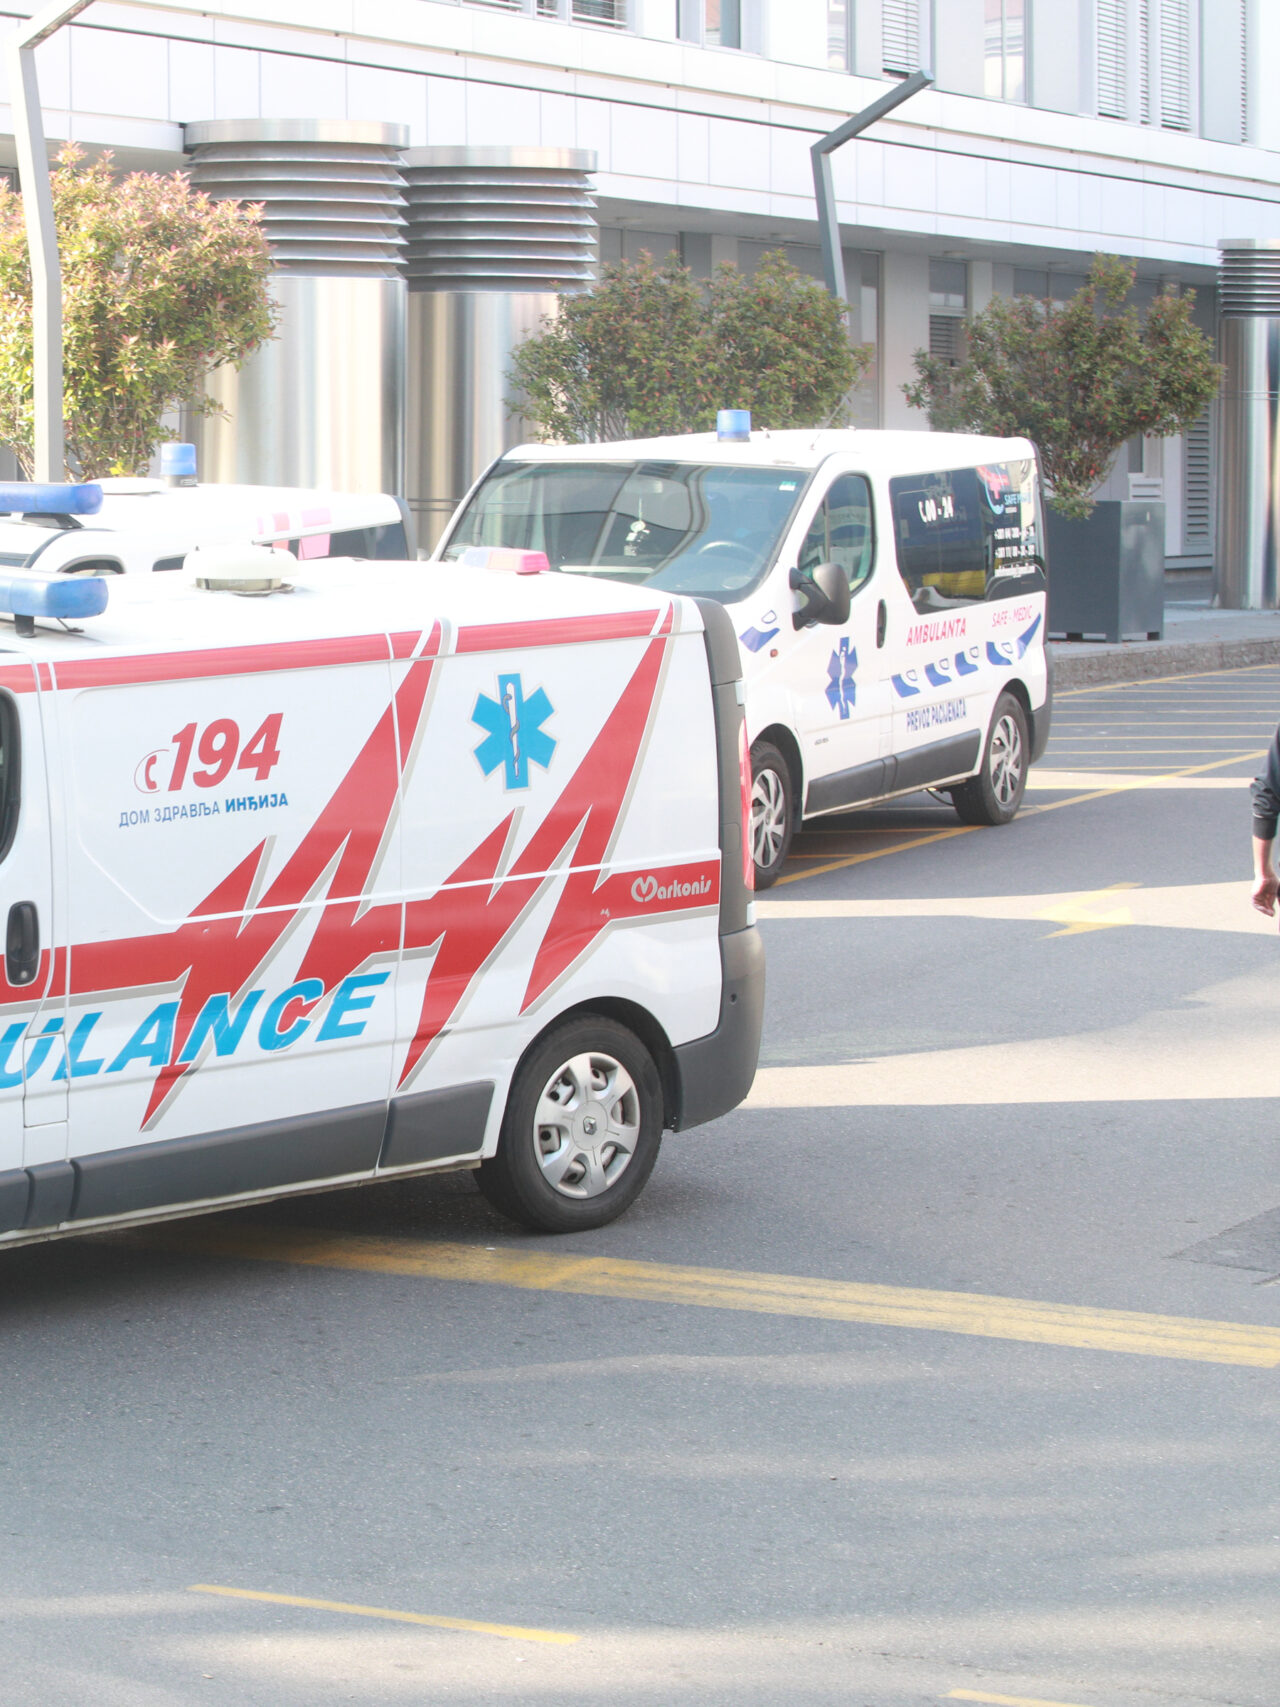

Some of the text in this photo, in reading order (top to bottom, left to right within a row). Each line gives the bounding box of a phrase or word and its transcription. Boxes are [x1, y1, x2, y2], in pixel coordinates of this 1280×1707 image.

[906, 617, 967, 647] AMBULANTA
[992, 610, 1008, 628] SAFE
[906, 697, 967, 733] PREVOZ PACIJENATA
[167, 712, 284, 792] 194
[119, 792, 289, 828] ДОМ ЗДРАВЉА ИНЂИЈА
[631, 874, 712, 903] Markonis
